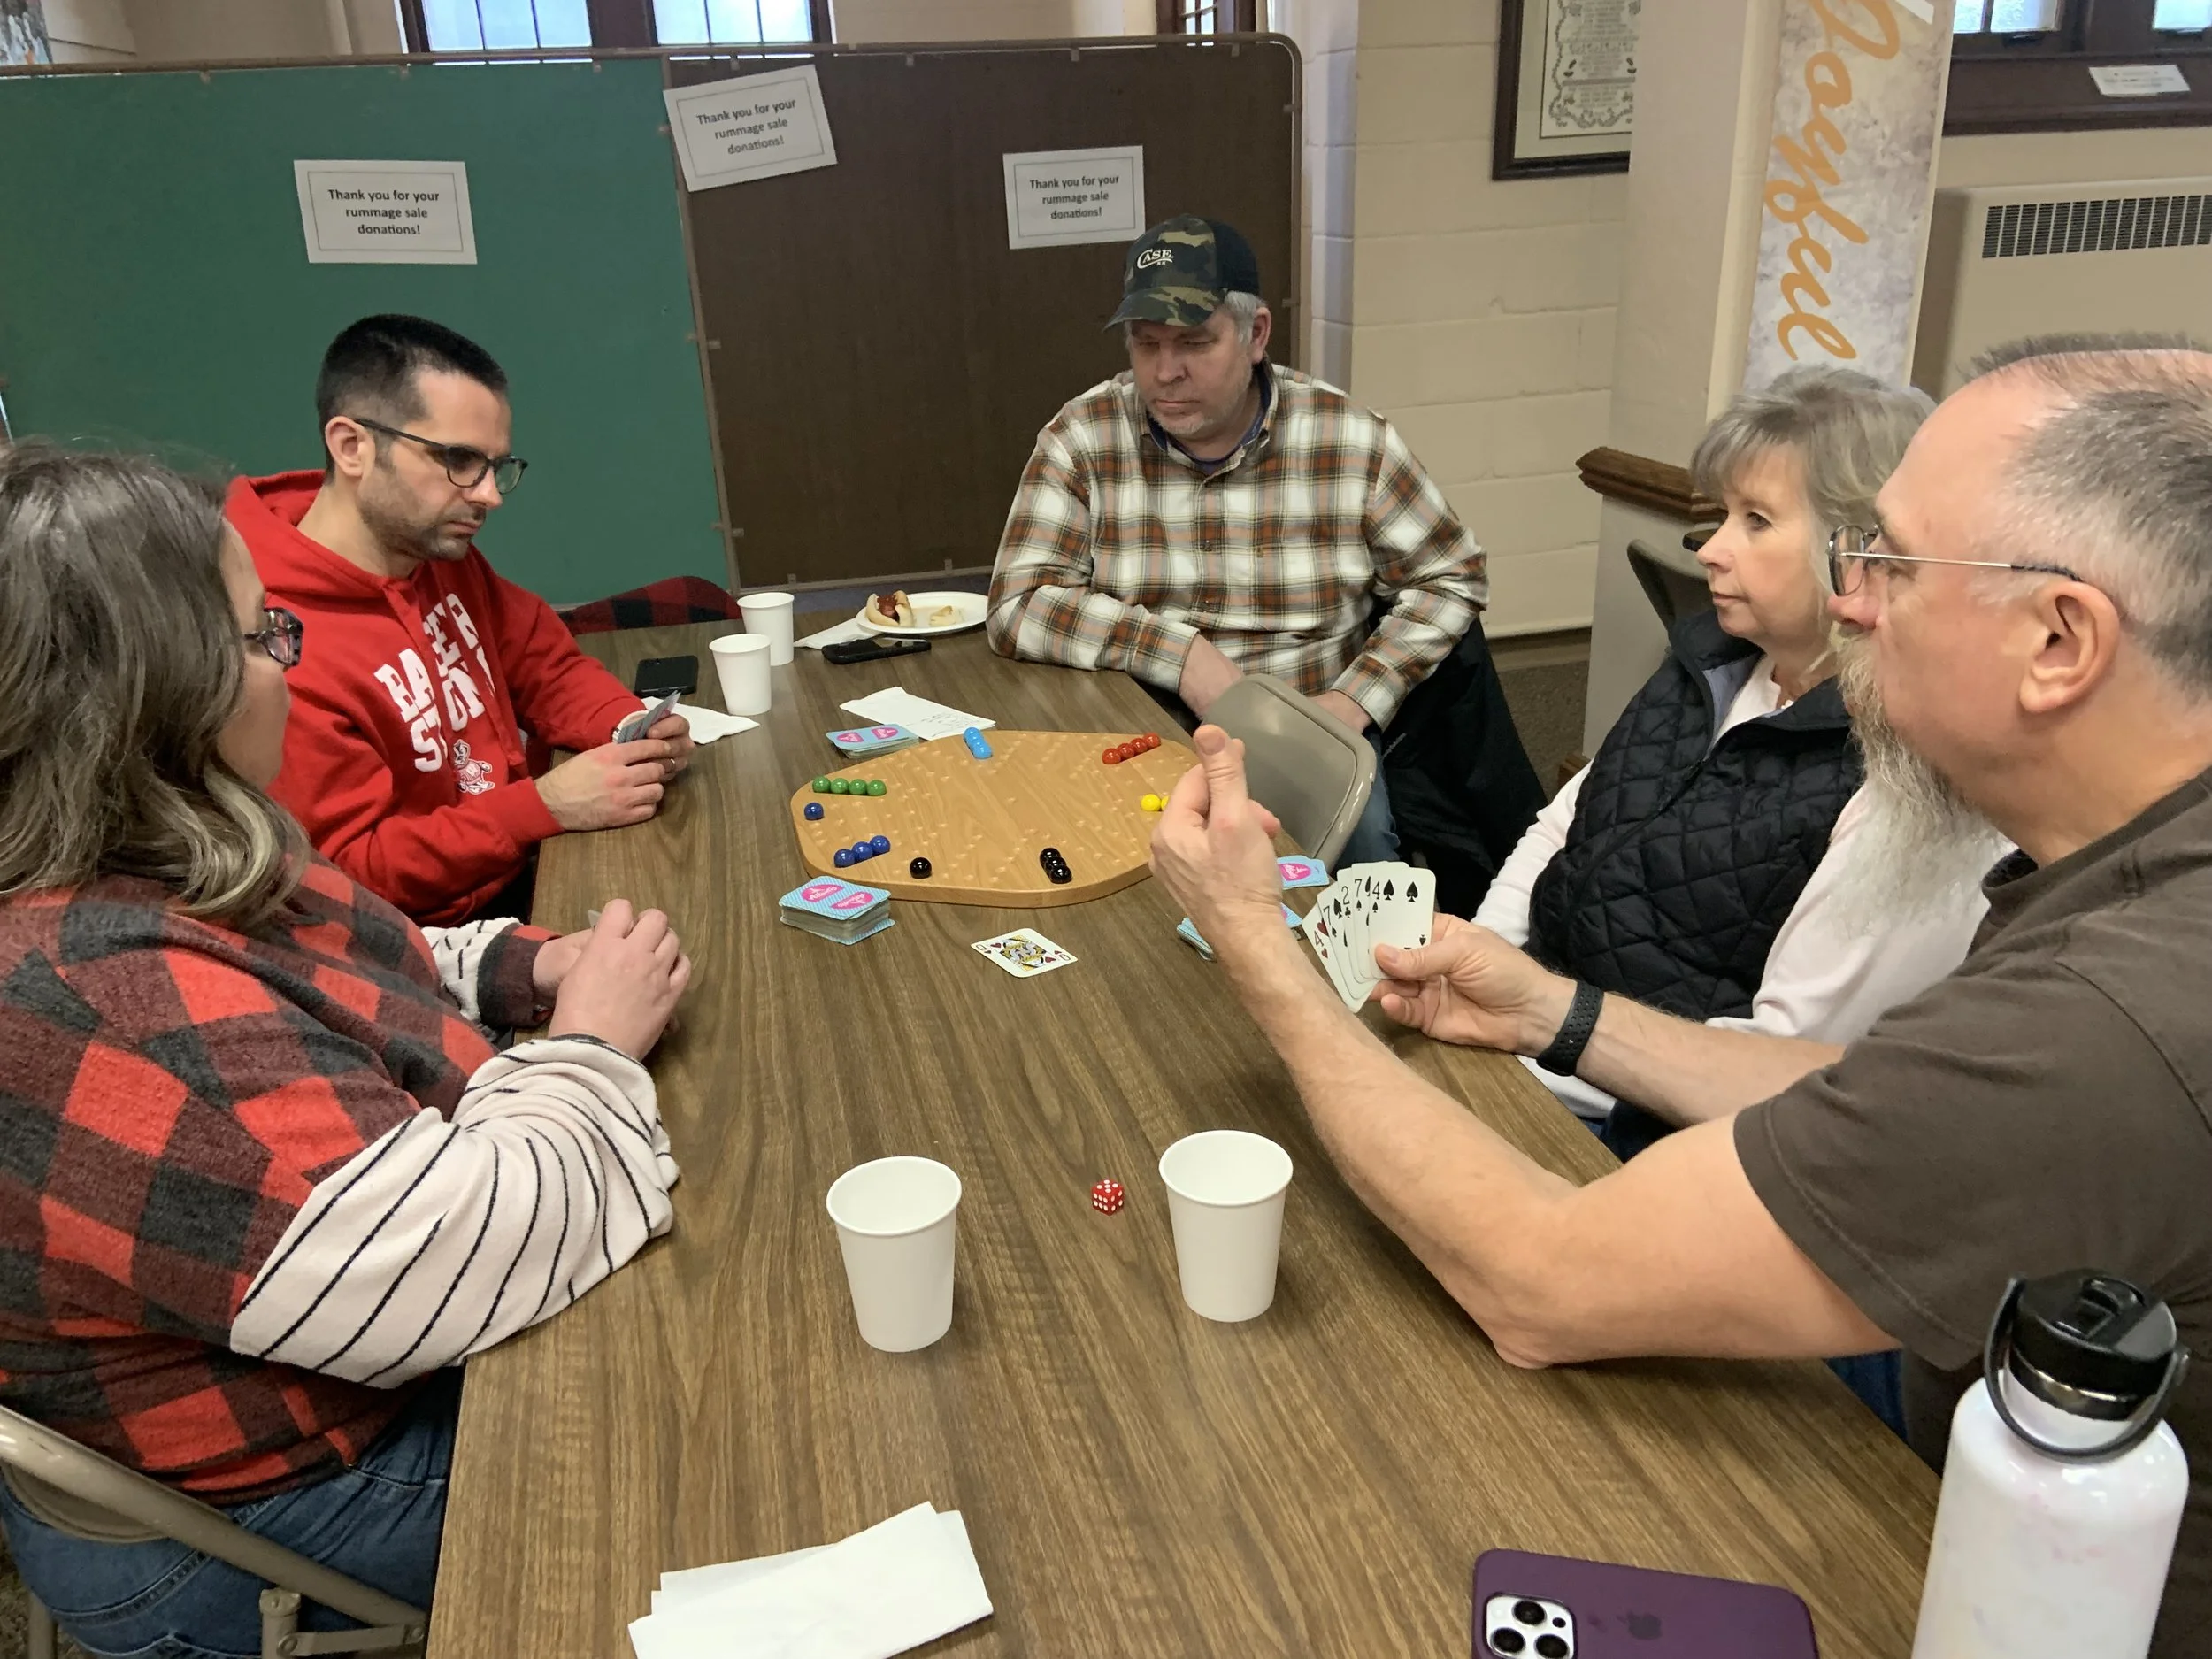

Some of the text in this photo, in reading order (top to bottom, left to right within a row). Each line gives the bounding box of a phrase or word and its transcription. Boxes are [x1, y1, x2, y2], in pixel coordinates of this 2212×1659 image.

[696, 99, 796, 125] Thank you for your
[715, 118, 788, 140] rummage sale
[727, 134, 785, 155] donations!
[1030, 175, 1119, 189] Thank you for your
[327, 189, 440, 203] Thank you for your
[1042, 191, 1109, 205] rummage sale
[345, 207, 428, 219] rummage sale
[1051, 207, 1102, 219] donations!
[357, 224, 421, 235] donations!
[1137, 249, 1172, 269] CASE
[1341, 886, 1350, 905] 2
[1354, 879, 1363, 897] 7
[1372, 881, 1380, 900] 4
[1323, 905, 1332, 926] 7
[1314, 930, 1325, 948] 4
